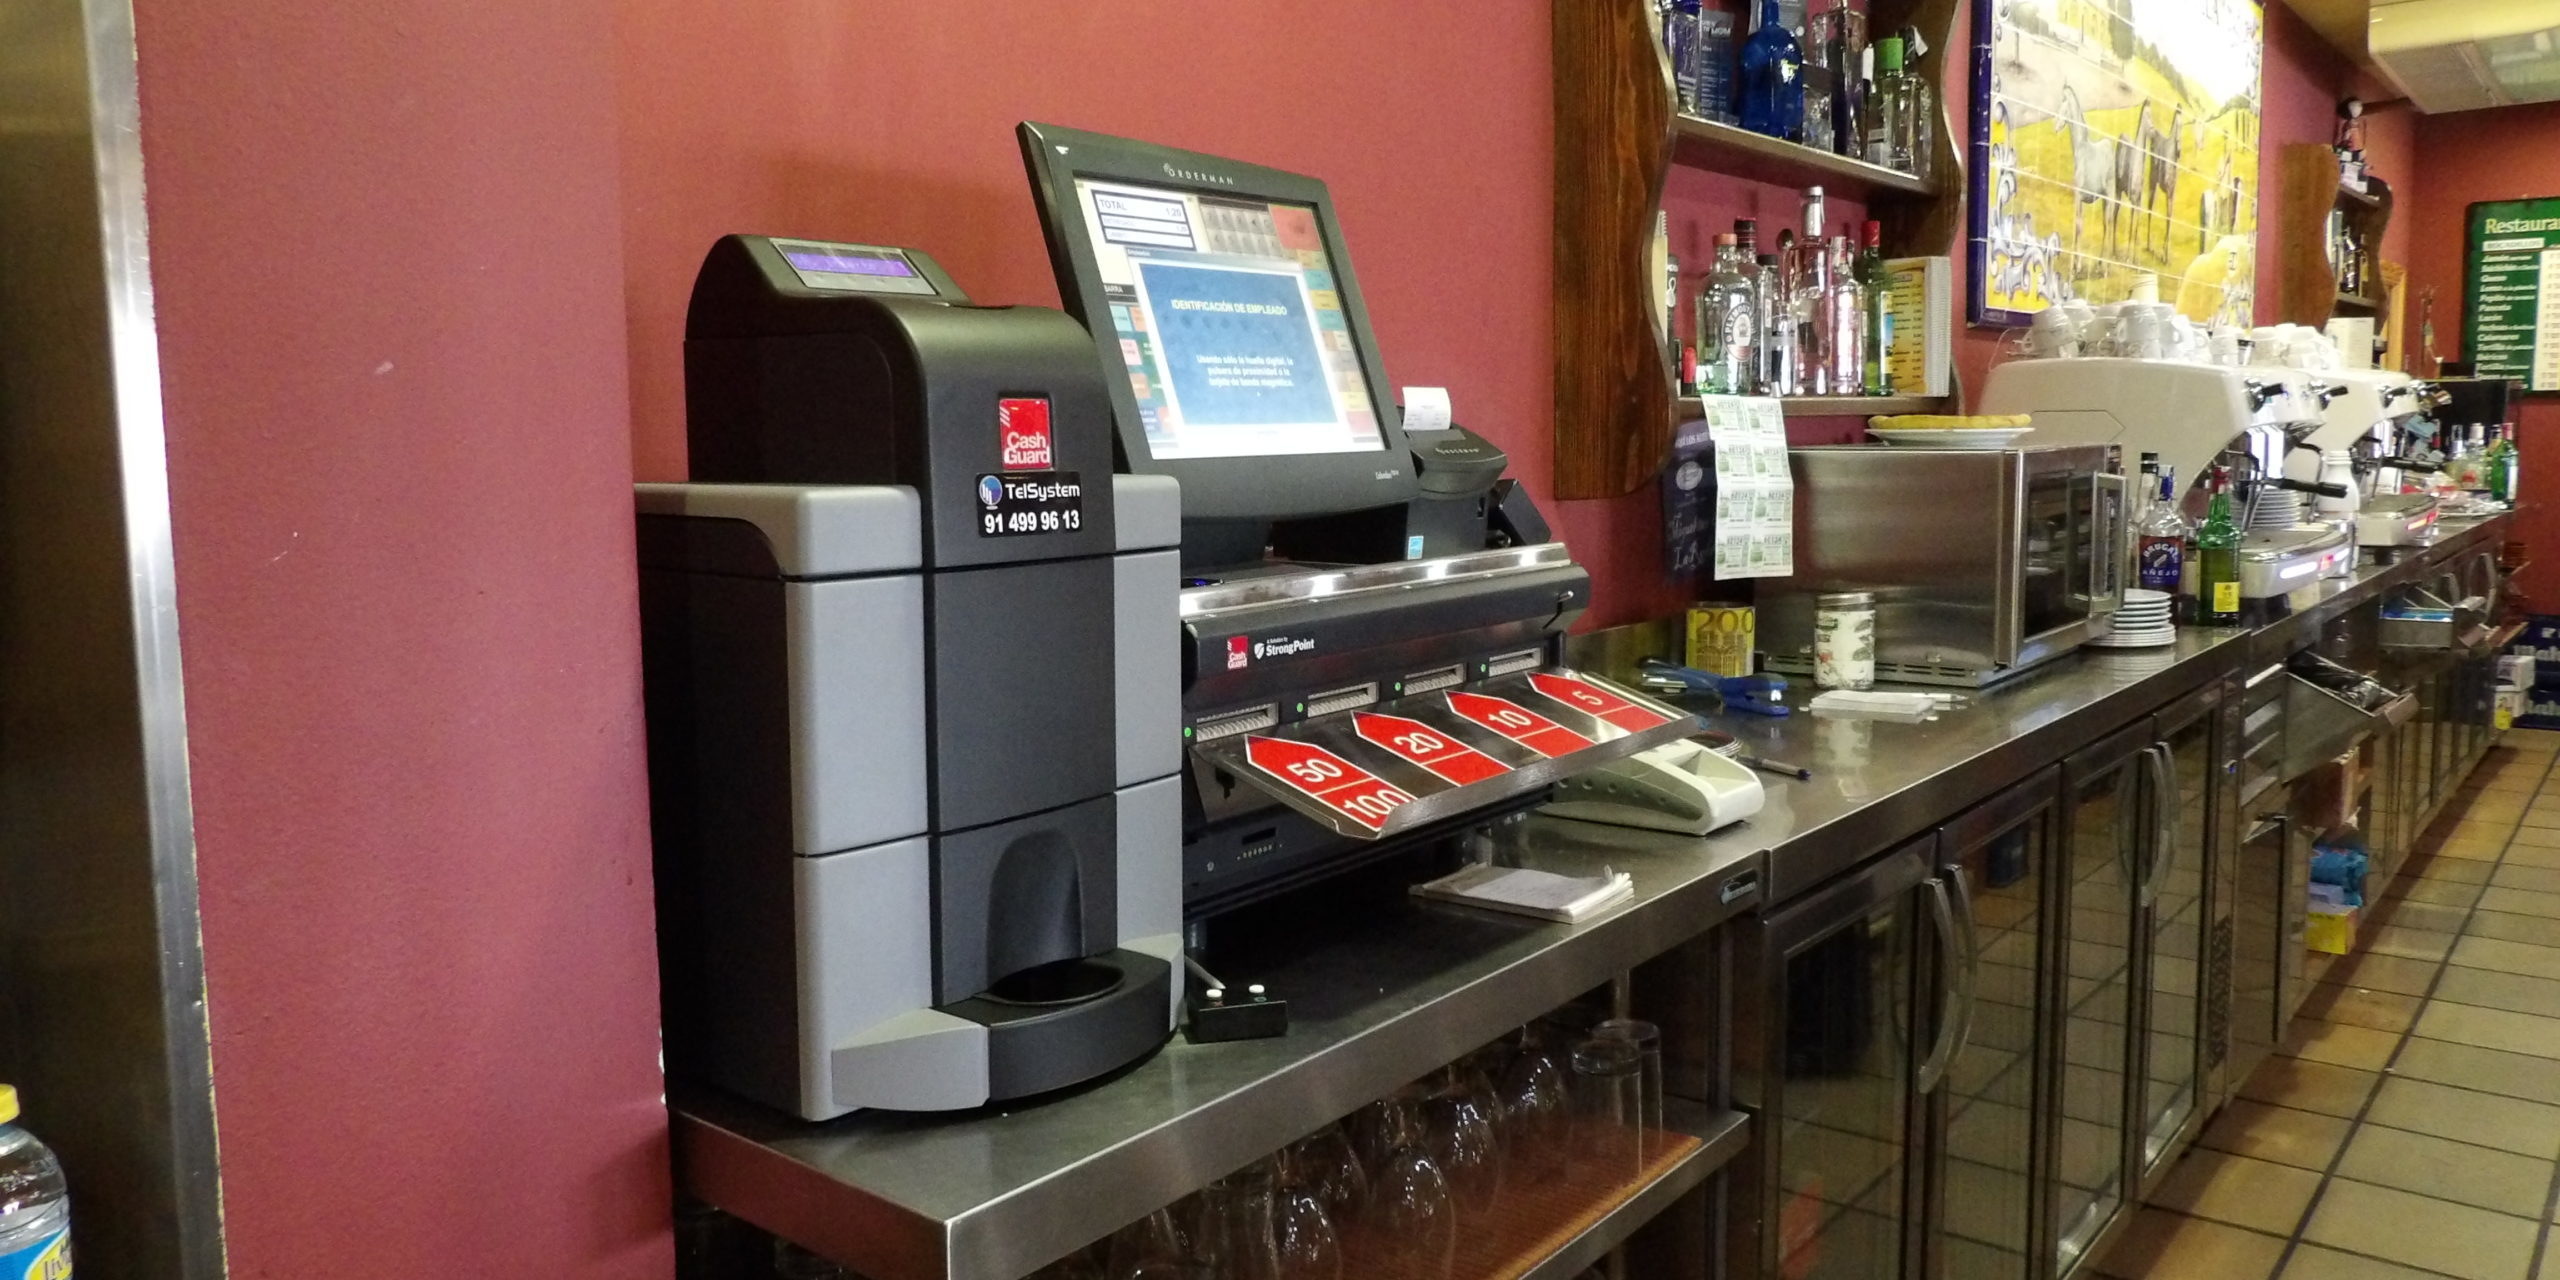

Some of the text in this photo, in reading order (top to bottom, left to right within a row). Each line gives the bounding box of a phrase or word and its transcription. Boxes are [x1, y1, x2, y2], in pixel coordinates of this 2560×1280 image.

[1168, 168, 1234, 186] ORDERMAN
[1099, 199, 1127, 211] TOTAL
[2484, 218, 2560, 234] Restaura
[1171, 299, 1288, 316] IDENTIFICACIÓN DE EMPLEADO
[1007, 431, 1047, 449] Cash
[1003, 446, 1051, 465] Guard
[1004, 482, 1081, 502] TelSystem
[984, 509, 1080, 534] 91 499 96 13
[2142, 568, 2179, 577] AÑEJO
[1696, 609, 1754, 634] 200
[1229, 651, 1247, 661] Cash
[1266, 638, 1315, 656] StrongPoint
[1227, 658, 1248, 669] Guard
[1572, 691, 1603, 706] 5
[1488, 710, 1532, 729] 10
[1393, 732, 1444, 754] 20
[1286, 759, 1343, 783] 50
[1343, 789, 1411, 819] 100
